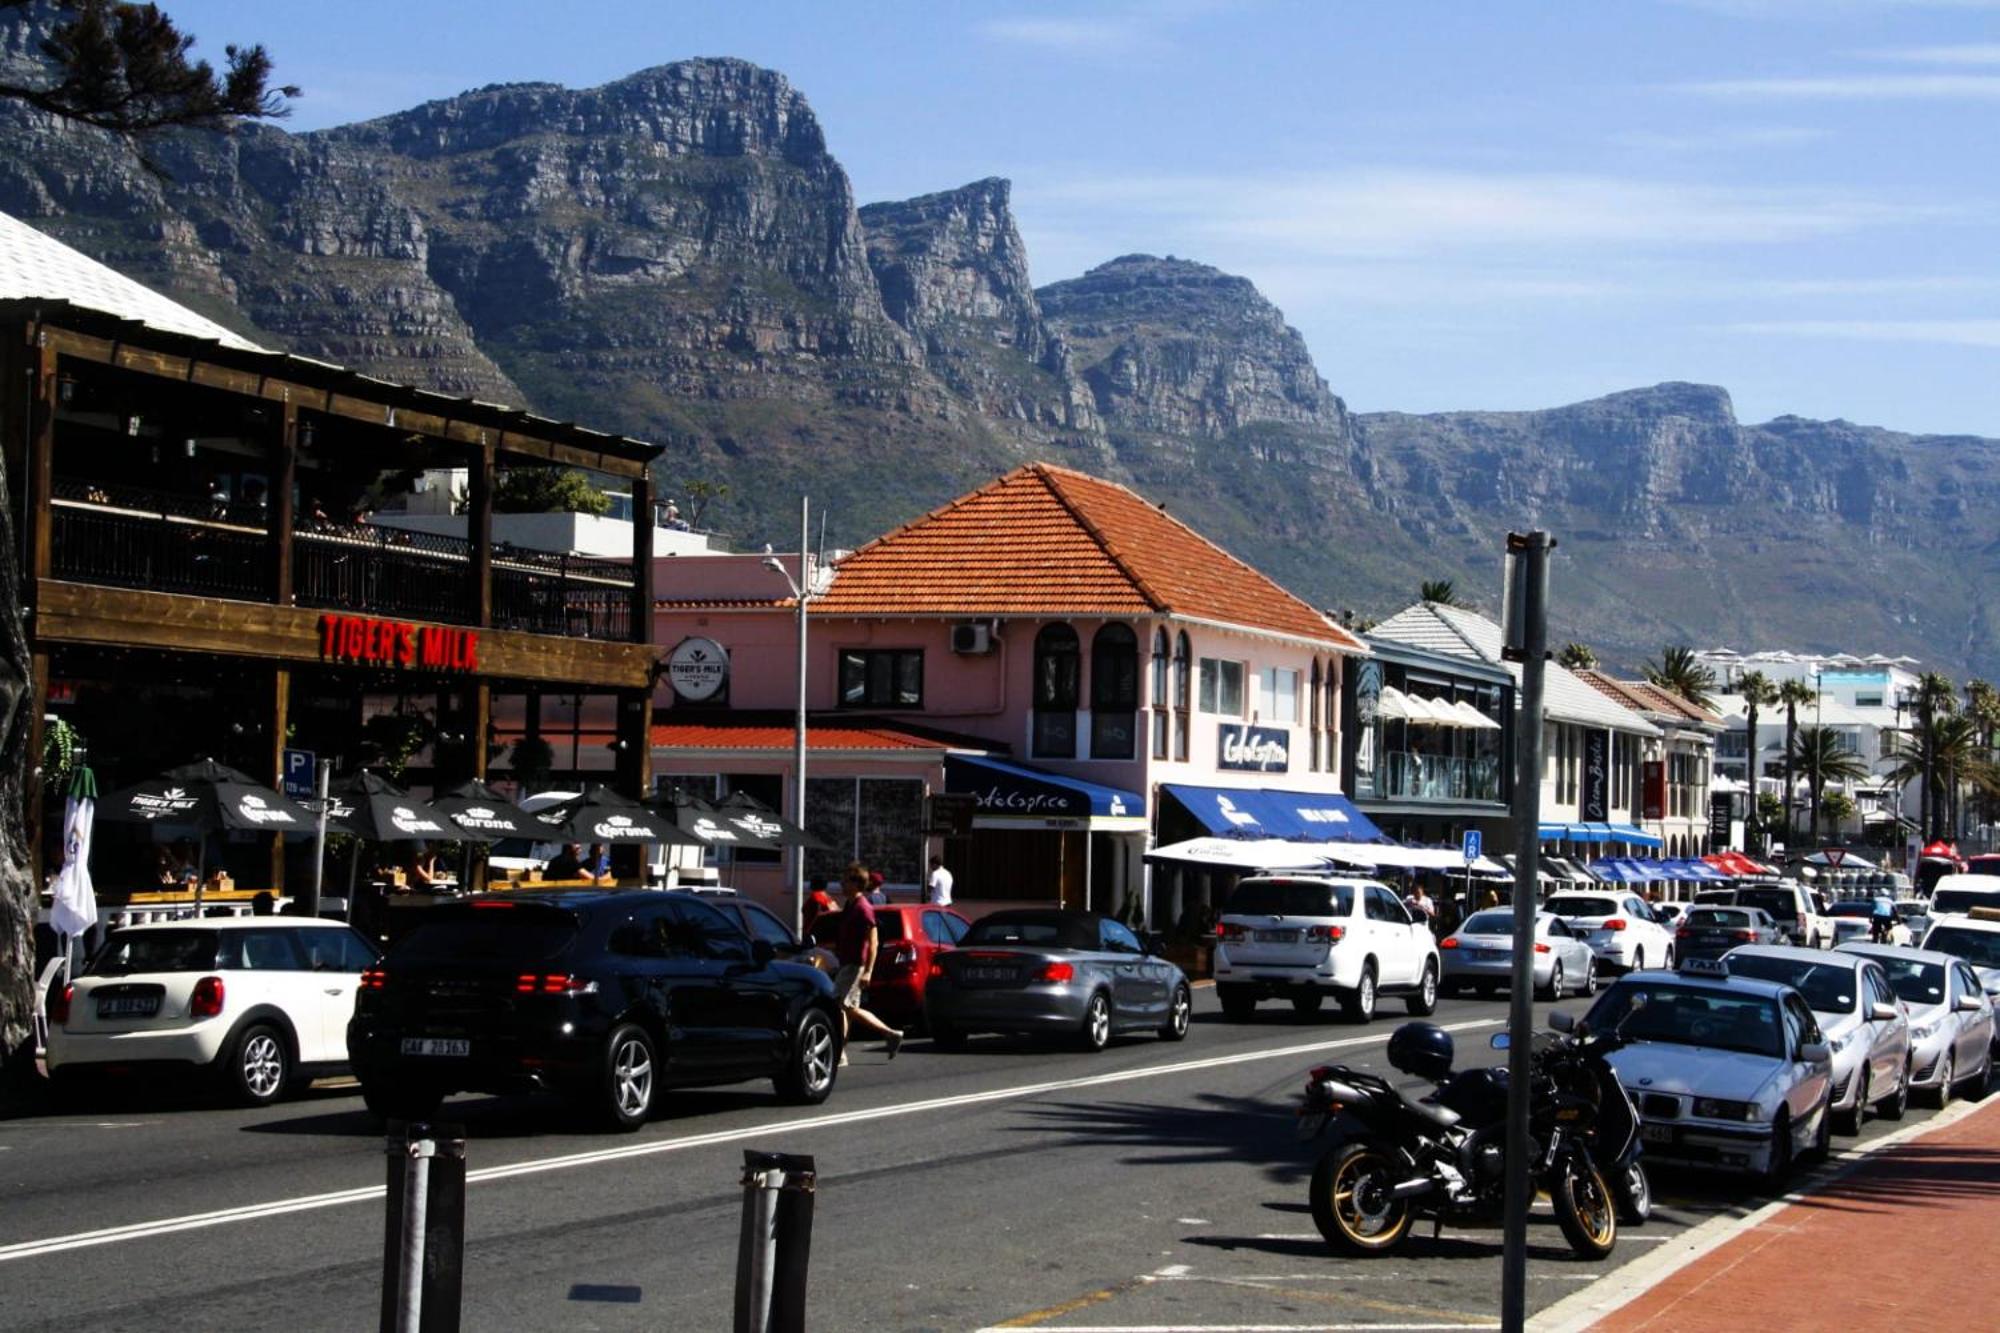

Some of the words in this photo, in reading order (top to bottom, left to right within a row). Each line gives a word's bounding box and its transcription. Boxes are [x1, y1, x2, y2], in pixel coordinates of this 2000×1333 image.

[323, 613, 416, 664] TIGER'S
[422, 626, 479, 672] MILK
[672, 665, 701, 673] TIGER'S
[703, 665, 721, 673] MILK
[291, 753, 305, 773] P
[970, 786, 1005, 808] afé
[593, 823, 656, 839] Corona
[1467, 848, 1477, 858] R
[1688, 959, 1721, 970] TAXI
